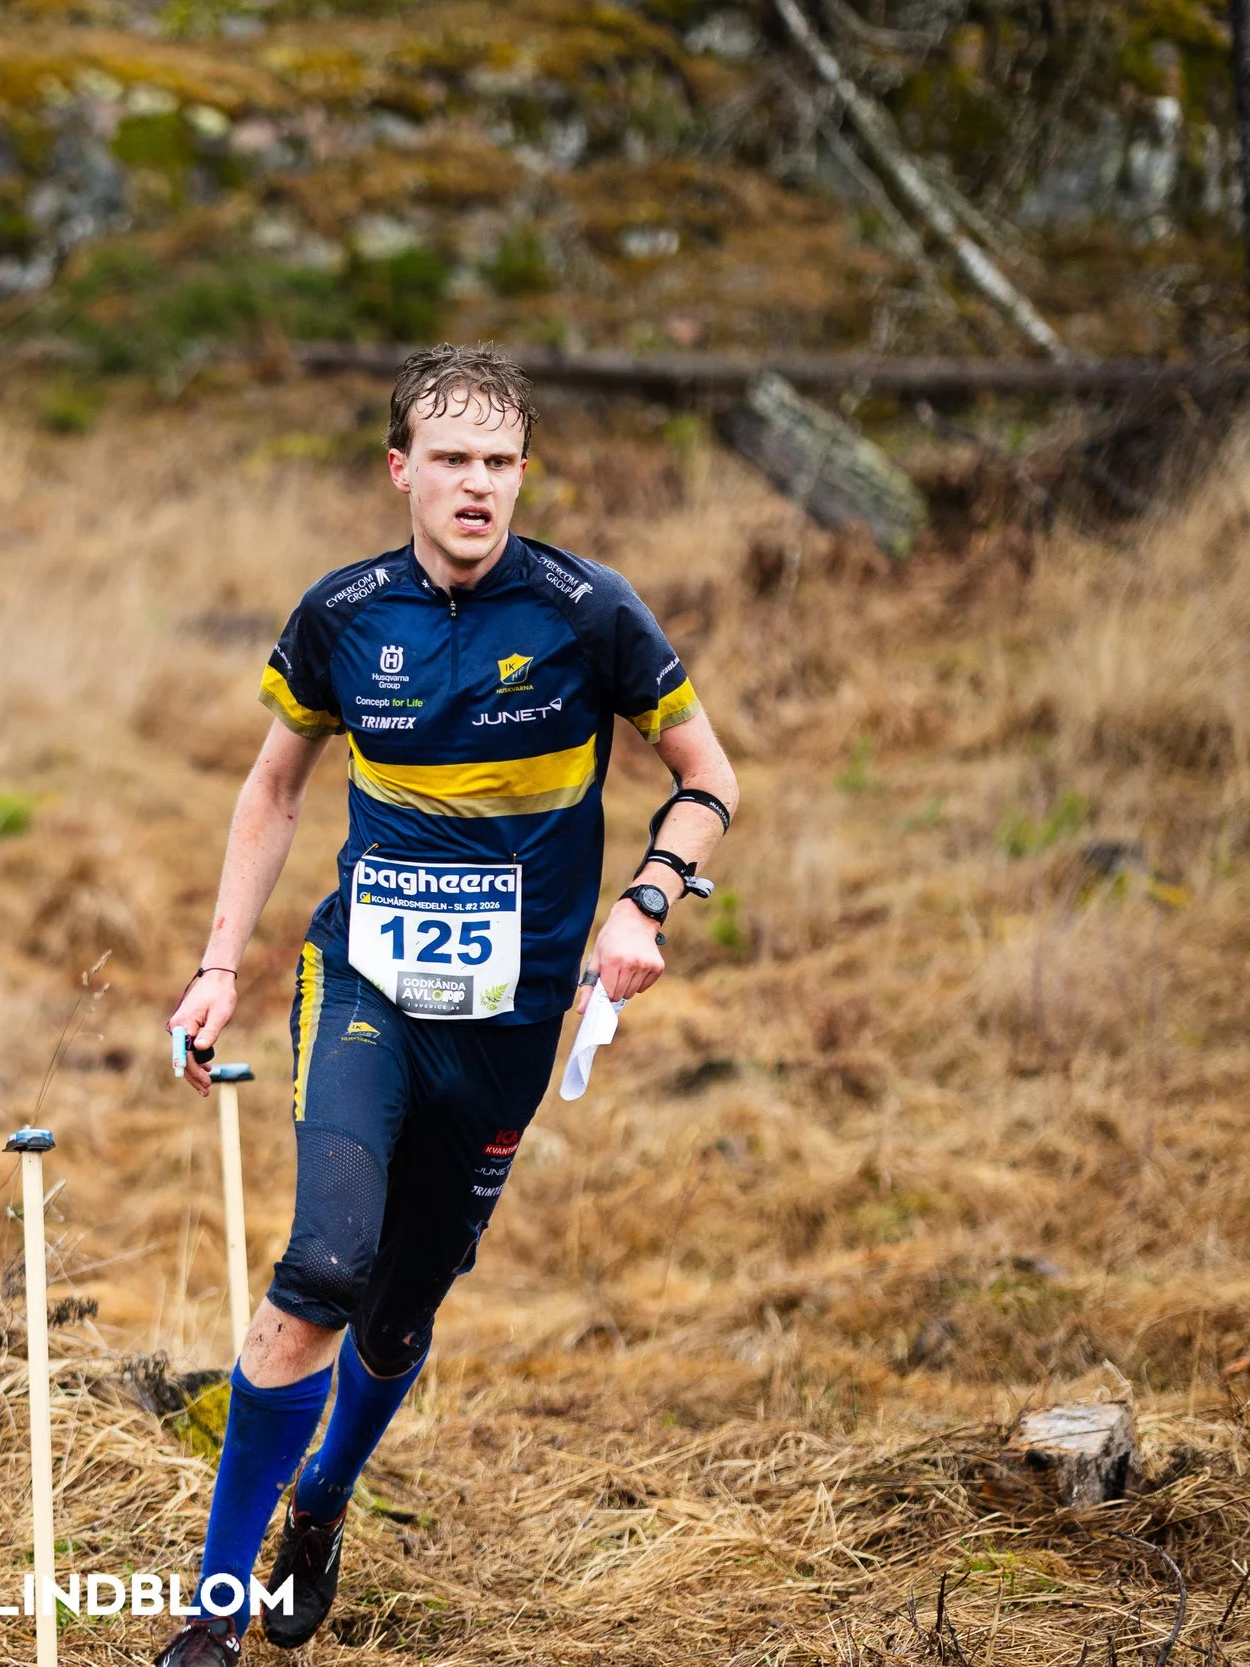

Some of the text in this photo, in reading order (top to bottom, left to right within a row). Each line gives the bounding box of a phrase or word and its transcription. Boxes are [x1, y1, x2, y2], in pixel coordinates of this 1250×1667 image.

[326, 573, 374, 608] CYBERCOM
[546, 572, 573, 594] GROUP
[347, 581, 377, 603] GROUP
[505, 663, 516, 672] IK
[372, 673, 410, 683] Husqvarna
[379, 681, 401, 690] Group
[496, 685, 534, 694] HUSKVARNA
[356, 696, 423, 708] Concept for Life
[361, 715, 416, 729] TRIMTEX
[472, 706, 551, 726] JUNET
[357, 861, 516, 896] bagheera
[371, 894, 447, 910] KOLMÅRDSMEDELN
[381, 915, 492, 965] 125
[403, 978, 466, 991] GODKÄNDA
